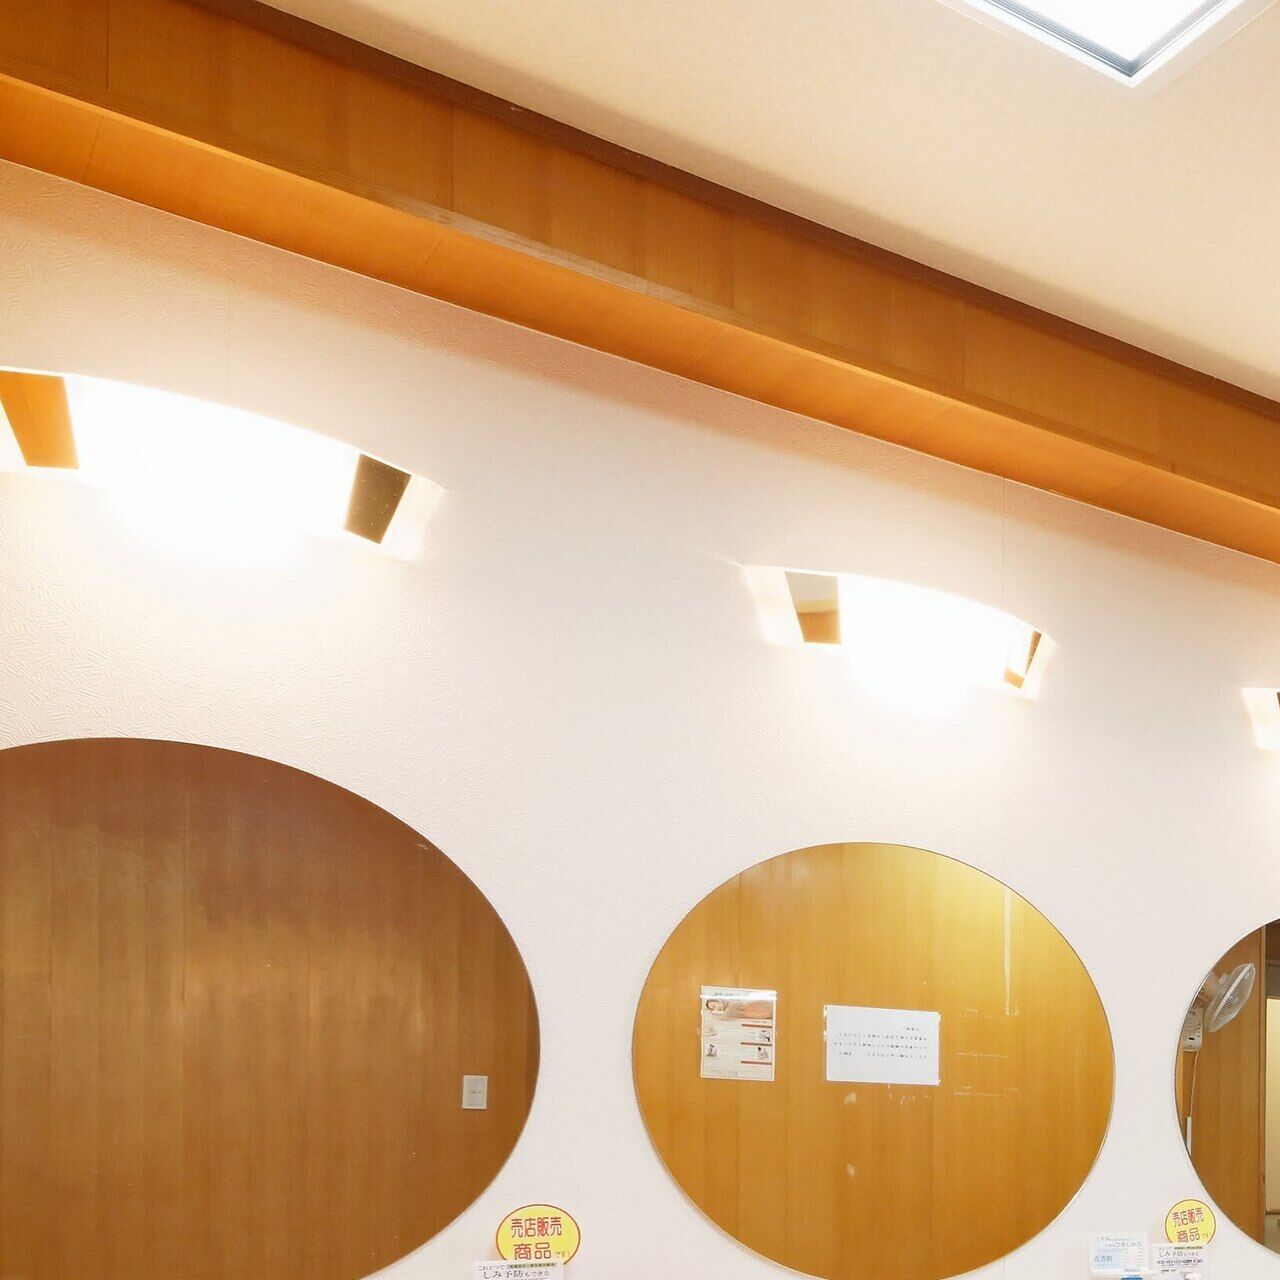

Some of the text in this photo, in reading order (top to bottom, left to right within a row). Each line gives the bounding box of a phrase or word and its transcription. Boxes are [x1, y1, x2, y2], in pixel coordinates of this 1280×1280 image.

[1172, 1207, 1205, 1227] 売店販売
[511, 1216, 563, 1239] 売店販売
[1176, 1228, 1201, 1243] 商品
[513, 1242, 552, 1260] 商品
